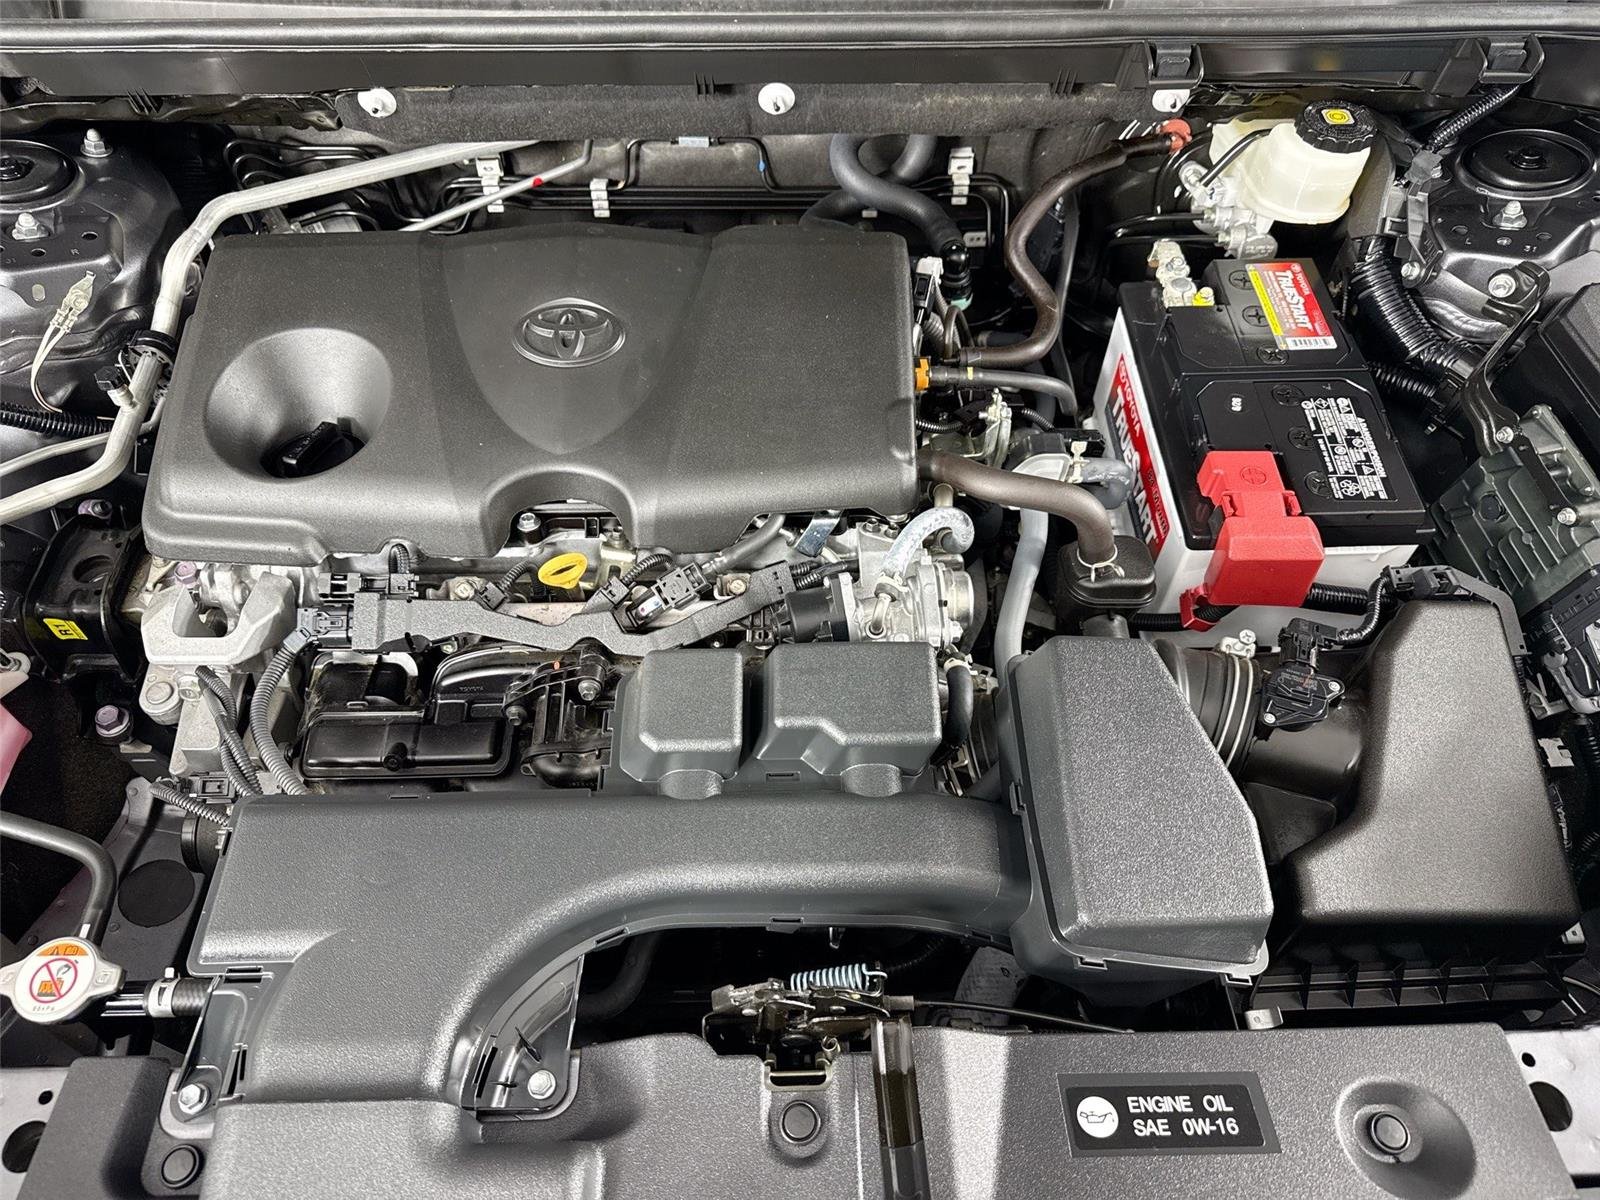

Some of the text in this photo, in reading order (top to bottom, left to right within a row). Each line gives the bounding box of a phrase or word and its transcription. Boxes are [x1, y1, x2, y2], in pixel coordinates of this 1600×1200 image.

[1126, 1094, 1234, 1114] ENGINE OIL
[1132, 1117, 1240, 1137] SAE 0W-16
